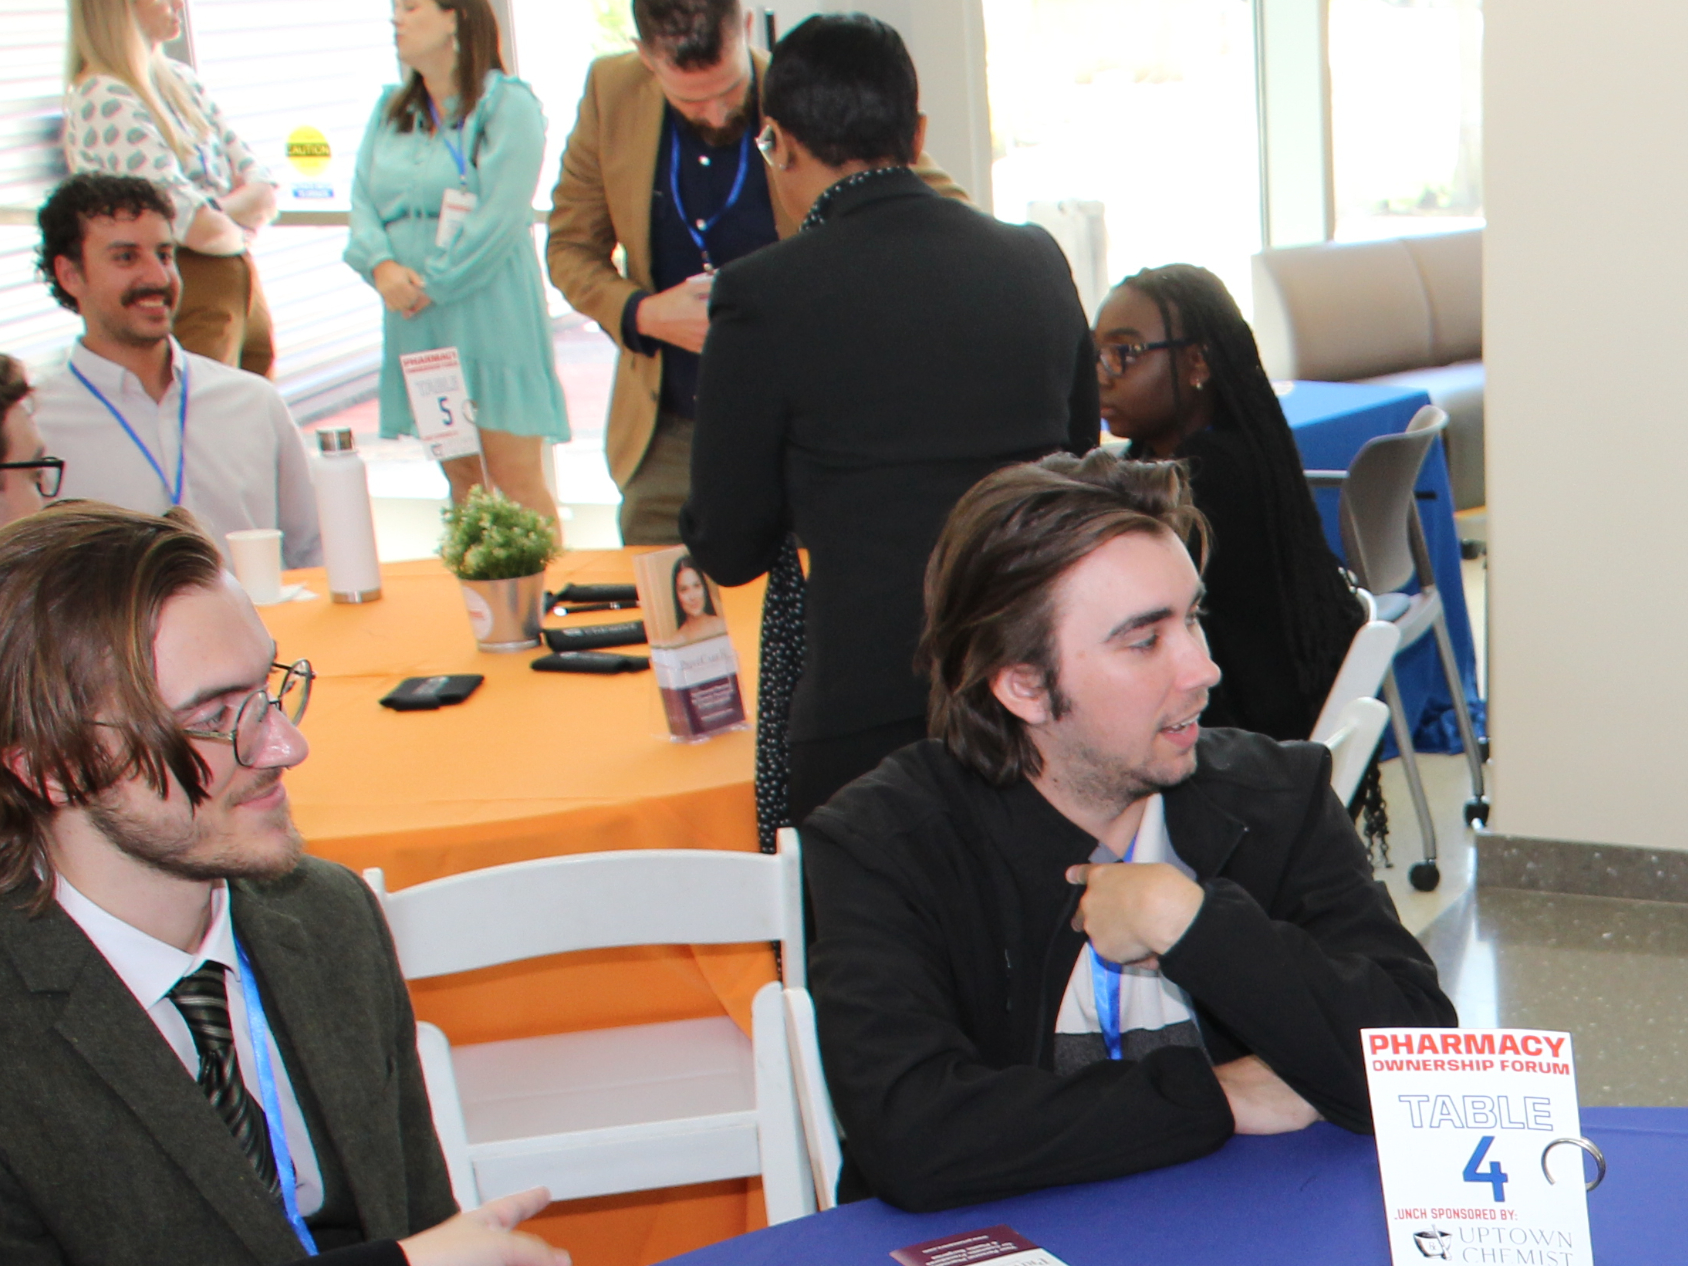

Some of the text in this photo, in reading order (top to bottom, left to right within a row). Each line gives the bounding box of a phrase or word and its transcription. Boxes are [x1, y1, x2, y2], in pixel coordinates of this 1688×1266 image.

[438, 396, 453, 426] 5
[1369, 1034, 1566, 1058] PHARMACY
[1372, 1059, 1570, 1075] OWNERSHIP FORUM
[1398, 1094, 1553, 1131] TABLE
[1462, 1135, 1508, 1203] 4
[1431, 1208, 1496, 1220] SPONSORED
[1459, 1227, 1572, 1248] UPTOWN
